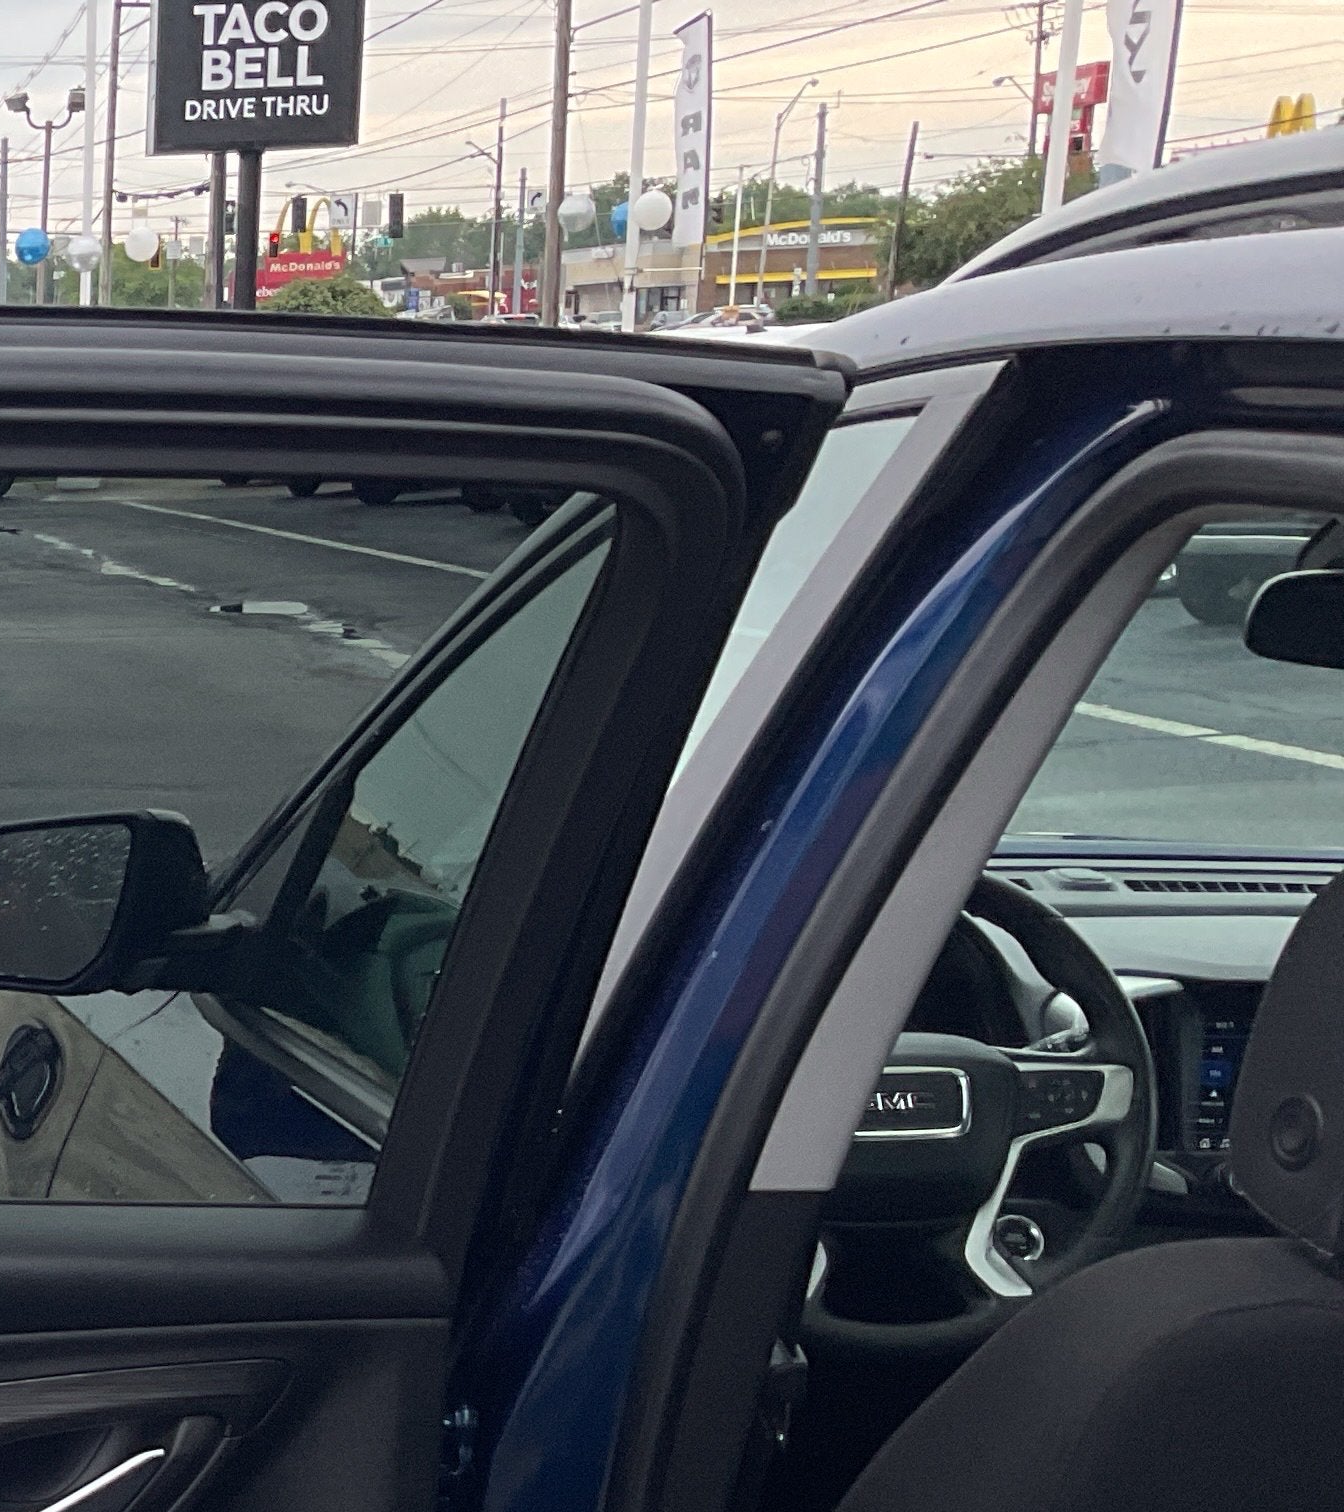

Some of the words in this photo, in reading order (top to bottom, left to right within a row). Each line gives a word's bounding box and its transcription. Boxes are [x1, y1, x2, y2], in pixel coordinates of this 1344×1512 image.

[193, 0, 329, 46] TACO
[201, 45, 324, 91] BELL
[184, 97, 257, 121] DRIVE
[262, 94, 329, 118] THRU
[767, 230, 851, 246] McDoald's
[270, 260, 341, 273] McDonald's
